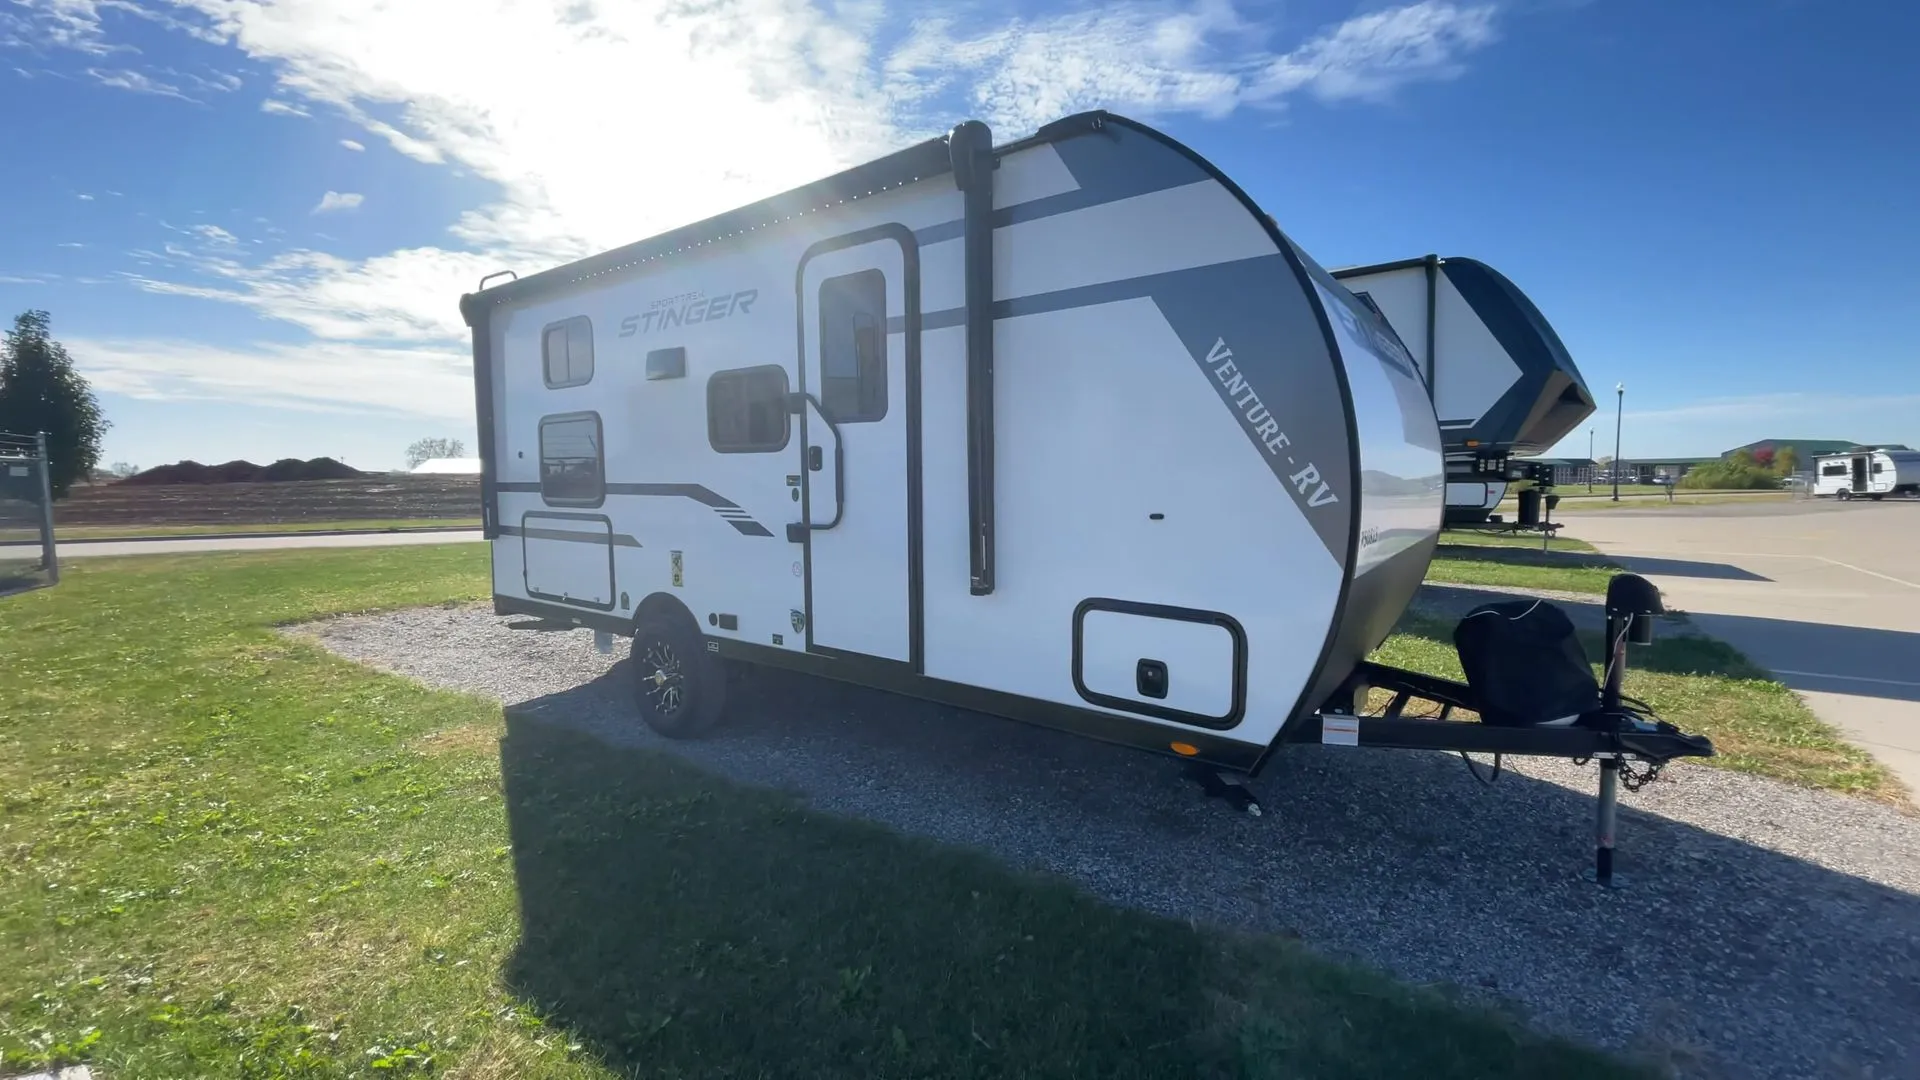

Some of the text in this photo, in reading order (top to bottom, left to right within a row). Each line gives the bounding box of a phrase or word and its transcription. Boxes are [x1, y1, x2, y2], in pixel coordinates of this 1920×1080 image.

[618, 289, 758, 338] STINGER
[1205, 337, 1291, 455] VENTURE
[1289, 462, 1339, 507] RV
